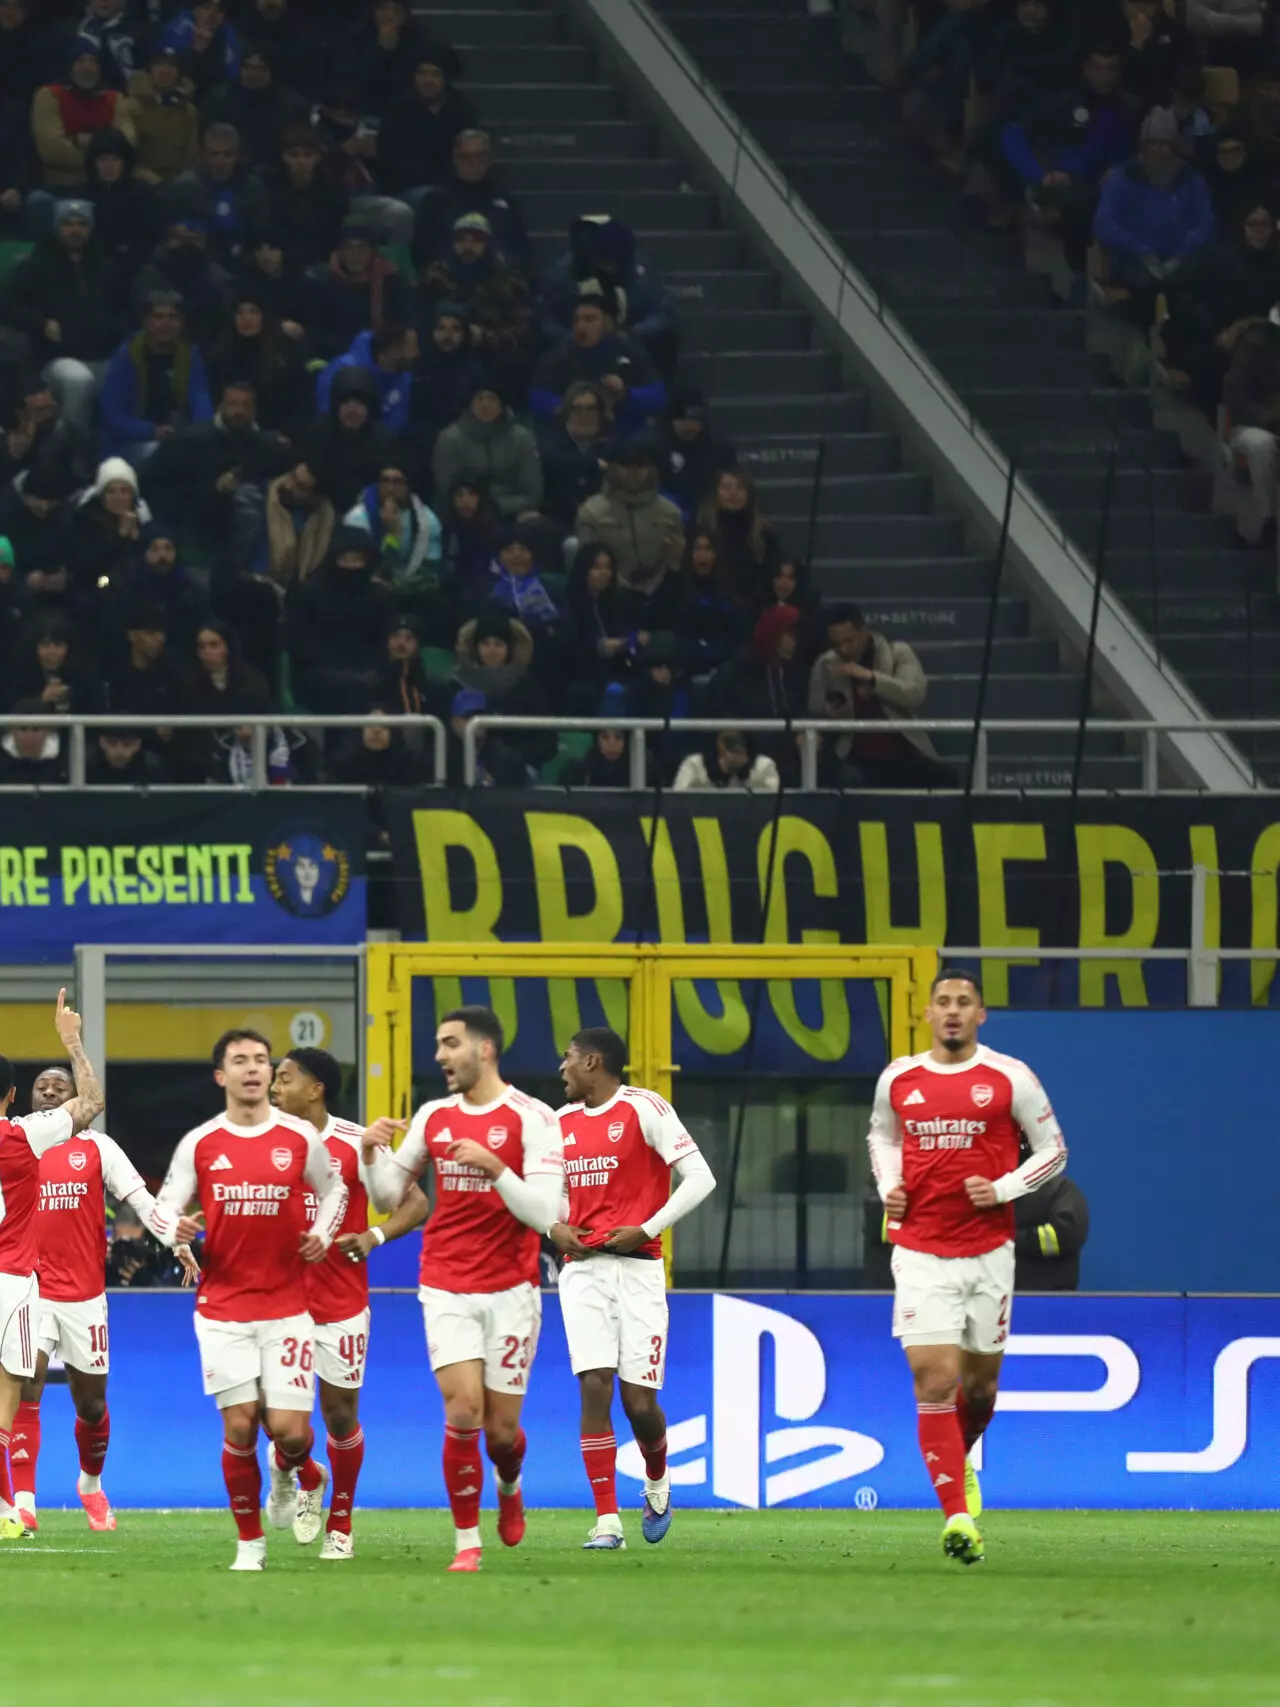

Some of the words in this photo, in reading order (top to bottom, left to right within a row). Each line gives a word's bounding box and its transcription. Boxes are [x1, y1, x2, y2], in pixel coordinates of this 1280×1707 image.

[60, 844, 255, 905] PRESENTI
[297, 1018, 315, 1042] 21
[905, 1117, 987, 1136] Emirates
[39, 1181, 89, 1198] irates
[212, 1181, 291, 1201] Emirates
[580, 1172, 609, 1187] BETTER
[48, 1196, 80, 1211] BETTER
[224, 1202, 241, 1217] FLY
[241, 1202, 280, 1217] BETTER
[87, 1324, 108, 1353] 10
[339, 1333, 365, 1367] 49
[649, 1335, 662, 1366] 3
[281, 1336, 313, 1372] 36
[501, 1335, 531, 1369] 23
